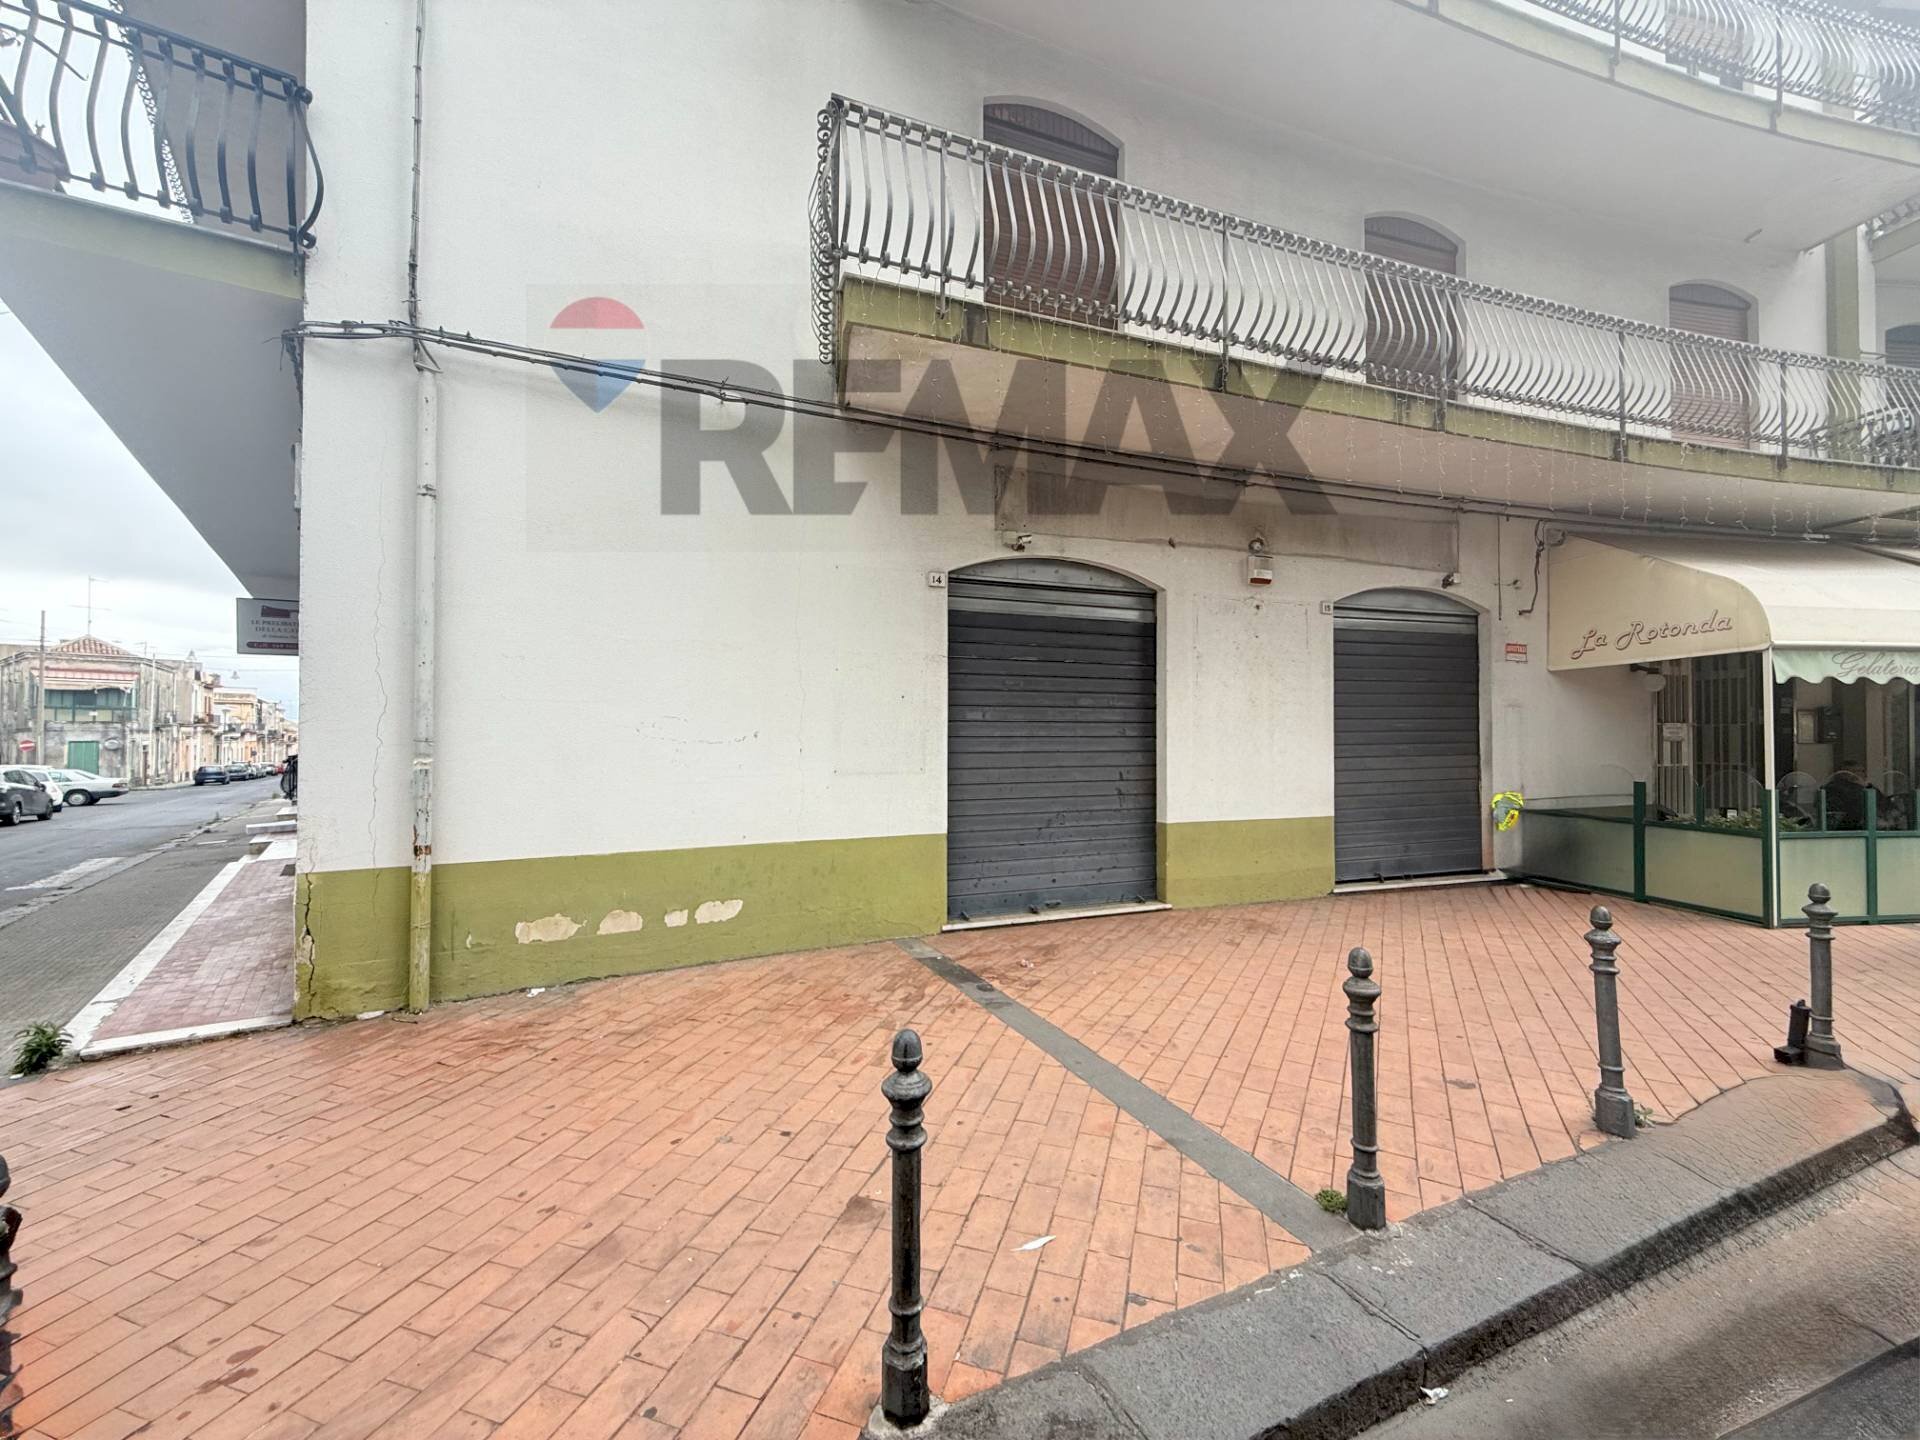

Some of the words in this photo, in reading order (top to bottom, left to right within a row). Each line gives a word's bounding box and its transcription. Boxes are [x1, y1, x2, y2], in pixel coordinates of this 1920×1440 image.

[1570, 628, 1607, 660] La
[1615, 609, 1733, 651] Rotonda
[1832, 651, 1920, 677] Gelateria
